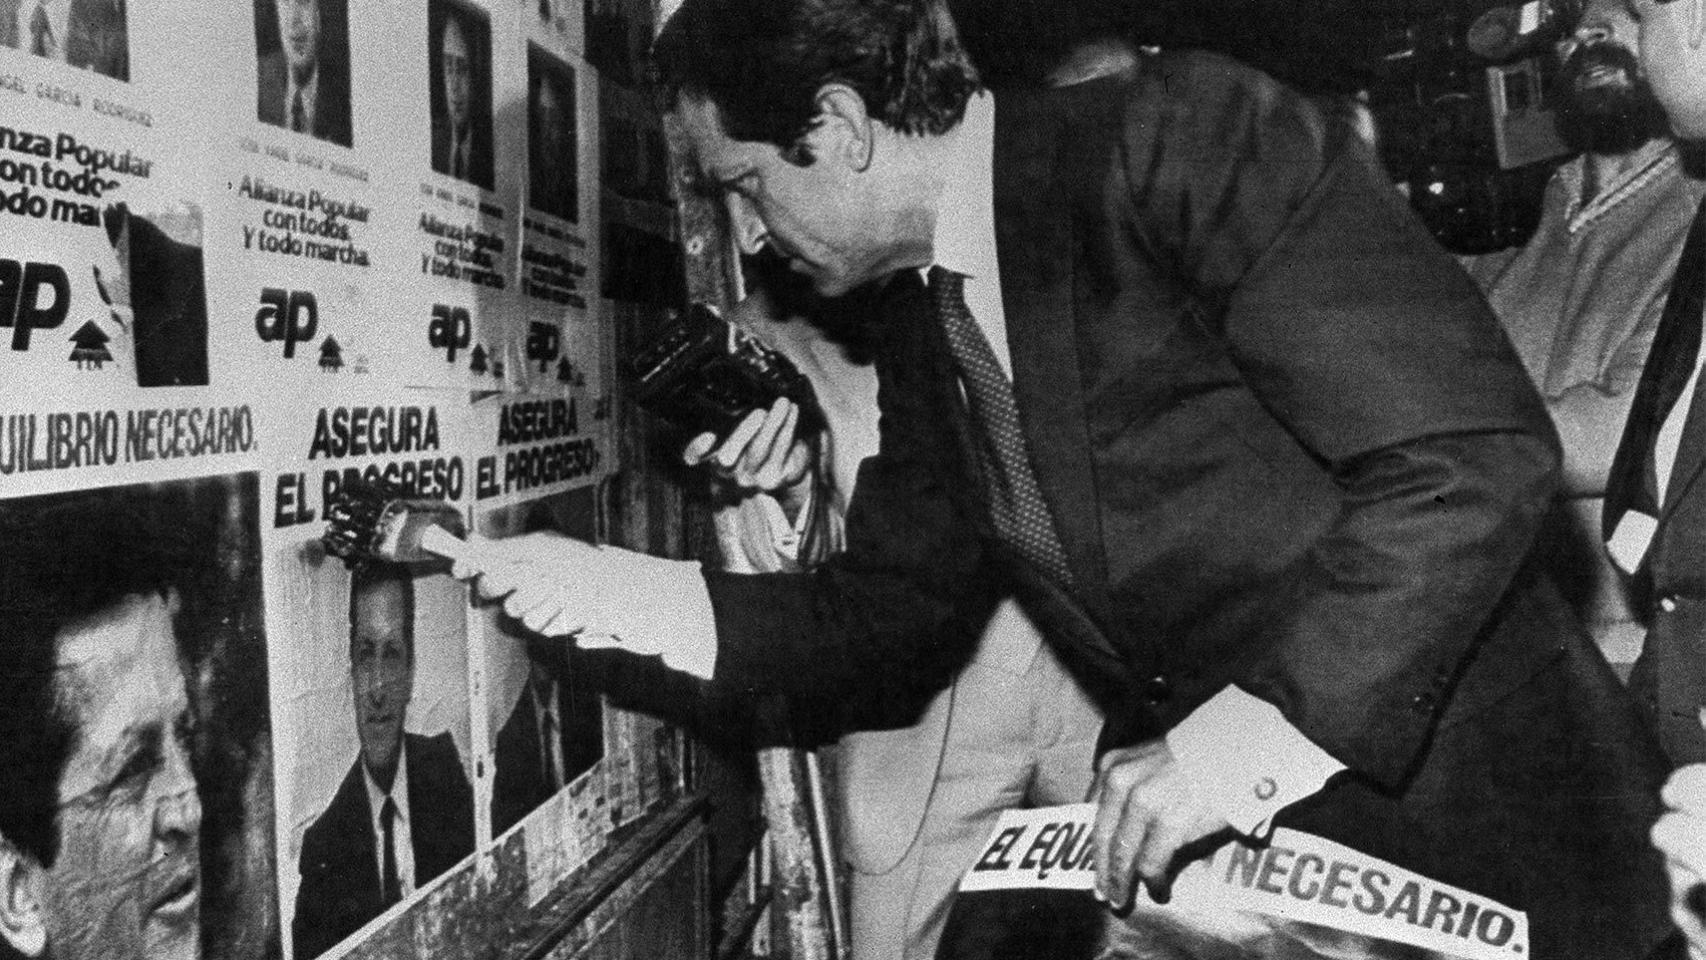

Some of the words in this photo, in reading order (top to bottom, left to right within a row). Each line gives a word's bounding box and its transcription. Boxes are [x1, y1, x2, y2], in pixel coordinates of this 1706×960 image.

[55, 132, 152, 178] Popular
[239, 175, 306, 211] Alianza
[308, 188, 370, 223] Popular
[263, 209, 298, 232] con
[243, 224, 255, 249] Y
[258, 230, 303, 257] todo
[255, 288, 318, 359] ap
[429, 304, 471, 363] ap
[308, 405, 440, 461] ASEGURA
[497, 397, 579, 447] ASEGURA
[476, 454, 501, 501] EL
[504, 437, 595, 494] PROGRESO
[274, 472, 315, 528] EL
[973, 825, 1028, 872] EL
[1224, 840, 1524, 953] NECESARIO.
